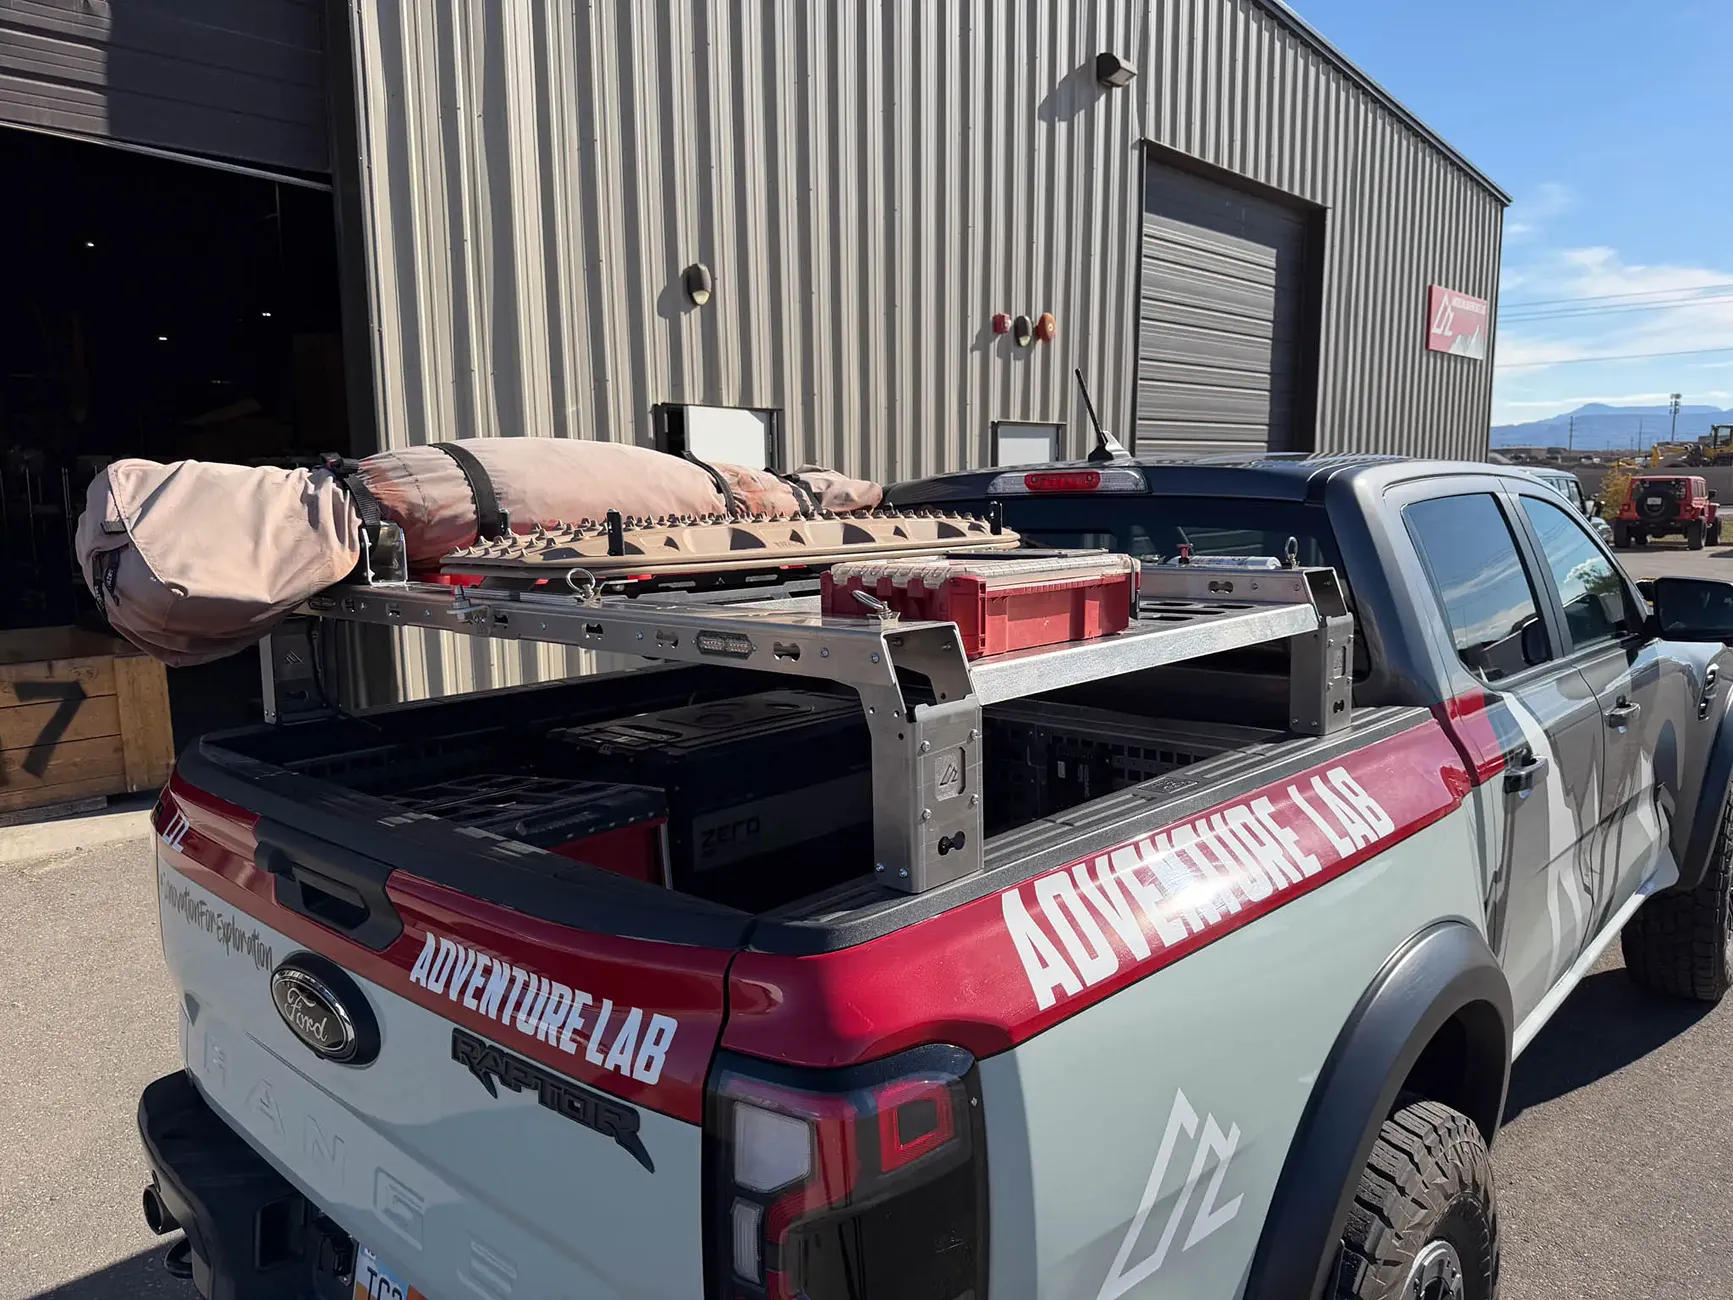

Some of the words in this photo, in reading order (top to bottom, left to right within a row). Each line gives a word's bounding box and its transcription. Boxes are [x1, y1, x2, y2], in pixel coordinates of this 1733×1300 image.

[1001, 796, 1322, 1012] ADVENTURE
[1288, 766, 1396, 860] LAB
[285, 987, 328, 1042] Ford
[409, 931, 593, 1055] ADVENTURE
[585, 998, 678, 1085] LAB
[451, 1027, 655, 1174] RAPTOR
